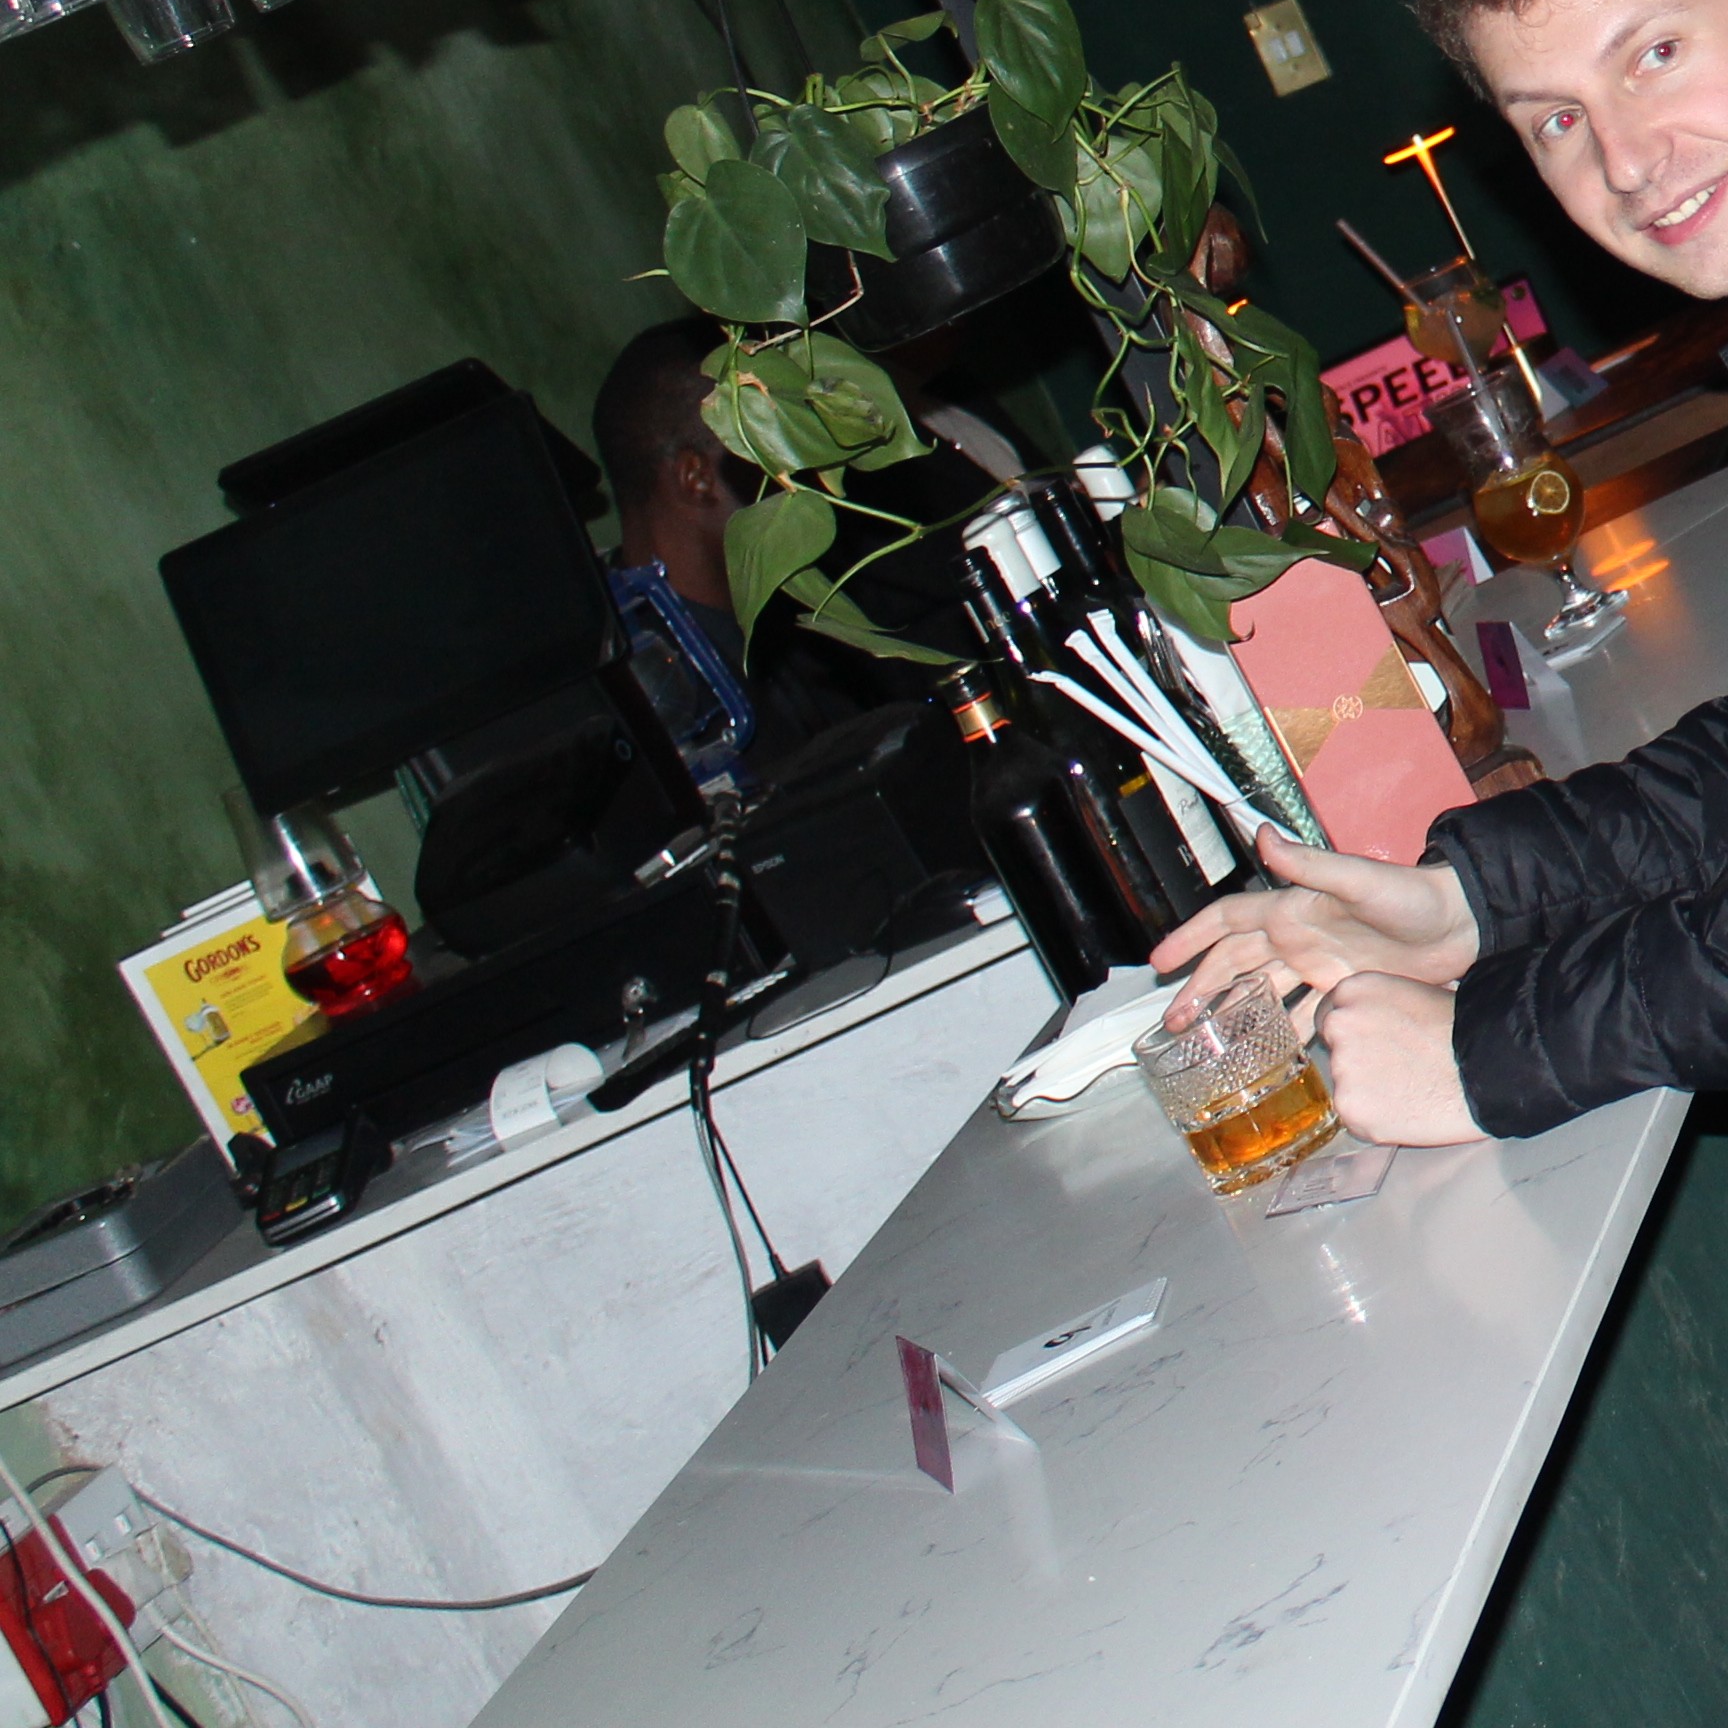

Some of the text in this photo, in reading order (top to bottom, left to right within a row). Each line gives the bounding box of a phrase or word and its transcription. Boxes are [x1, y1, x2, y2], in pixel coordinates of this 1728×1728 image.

[1337, 355, 1473, 425] PEE
[751, 853, 786, 874] EPSON
[184, 933, 261, 984] GORDON'S
